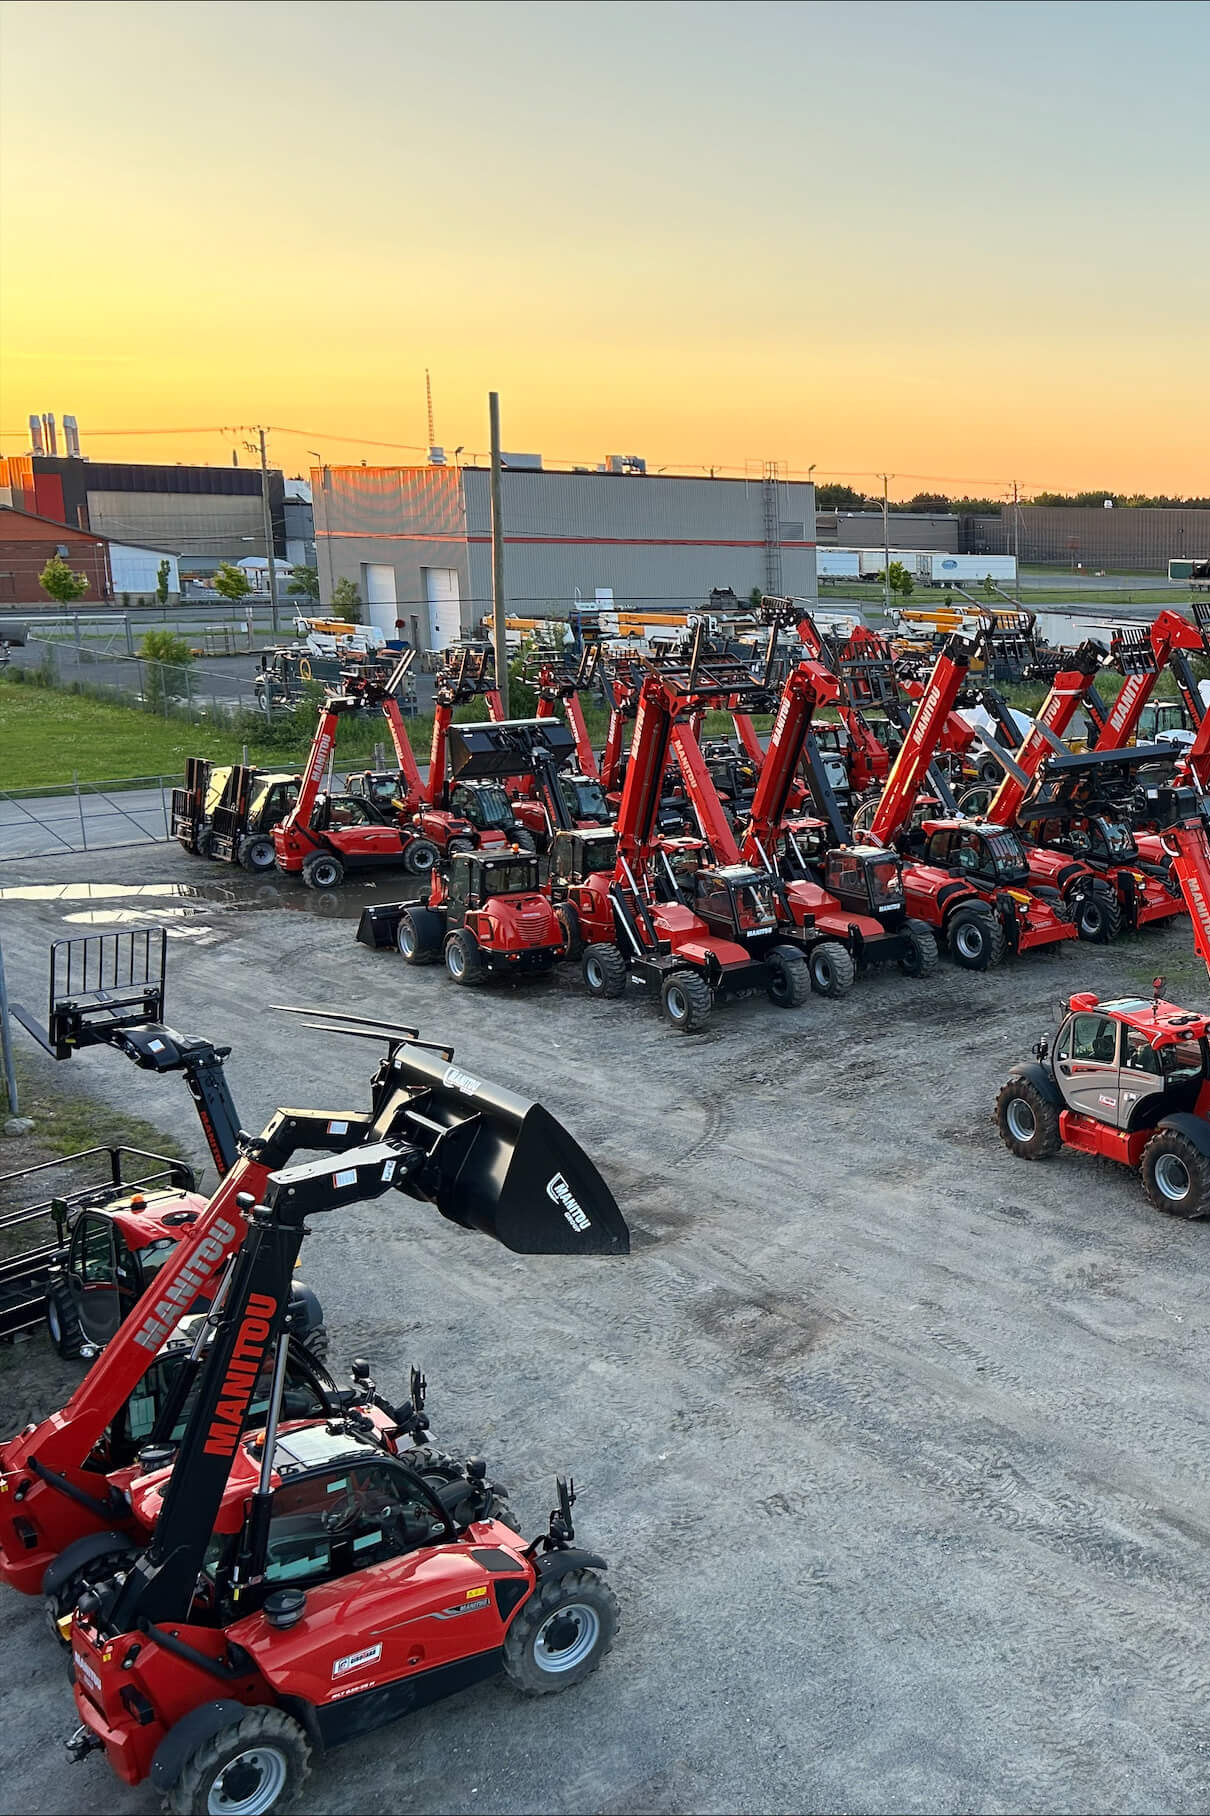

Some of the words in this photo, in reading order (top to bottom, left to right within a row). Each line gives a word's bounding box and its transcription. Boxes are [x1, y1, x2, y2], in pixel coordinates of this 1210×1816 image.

[772, 696, 791, 747] MANITOU
[912, 685, 941, 745] MANITOU
[1110, 673, 1145, 732] MANITO
[311, 733, 331, 782] MANITOU
[674, 739, 698, 789] MANITOU
[554, 1183, 592, 1230] MANITOU
[564, 1212, 581, 1233] GROUP
[133, 1216, 237, 1352] MANITOU
[203, 1293, 278, 1457] MANITOU
